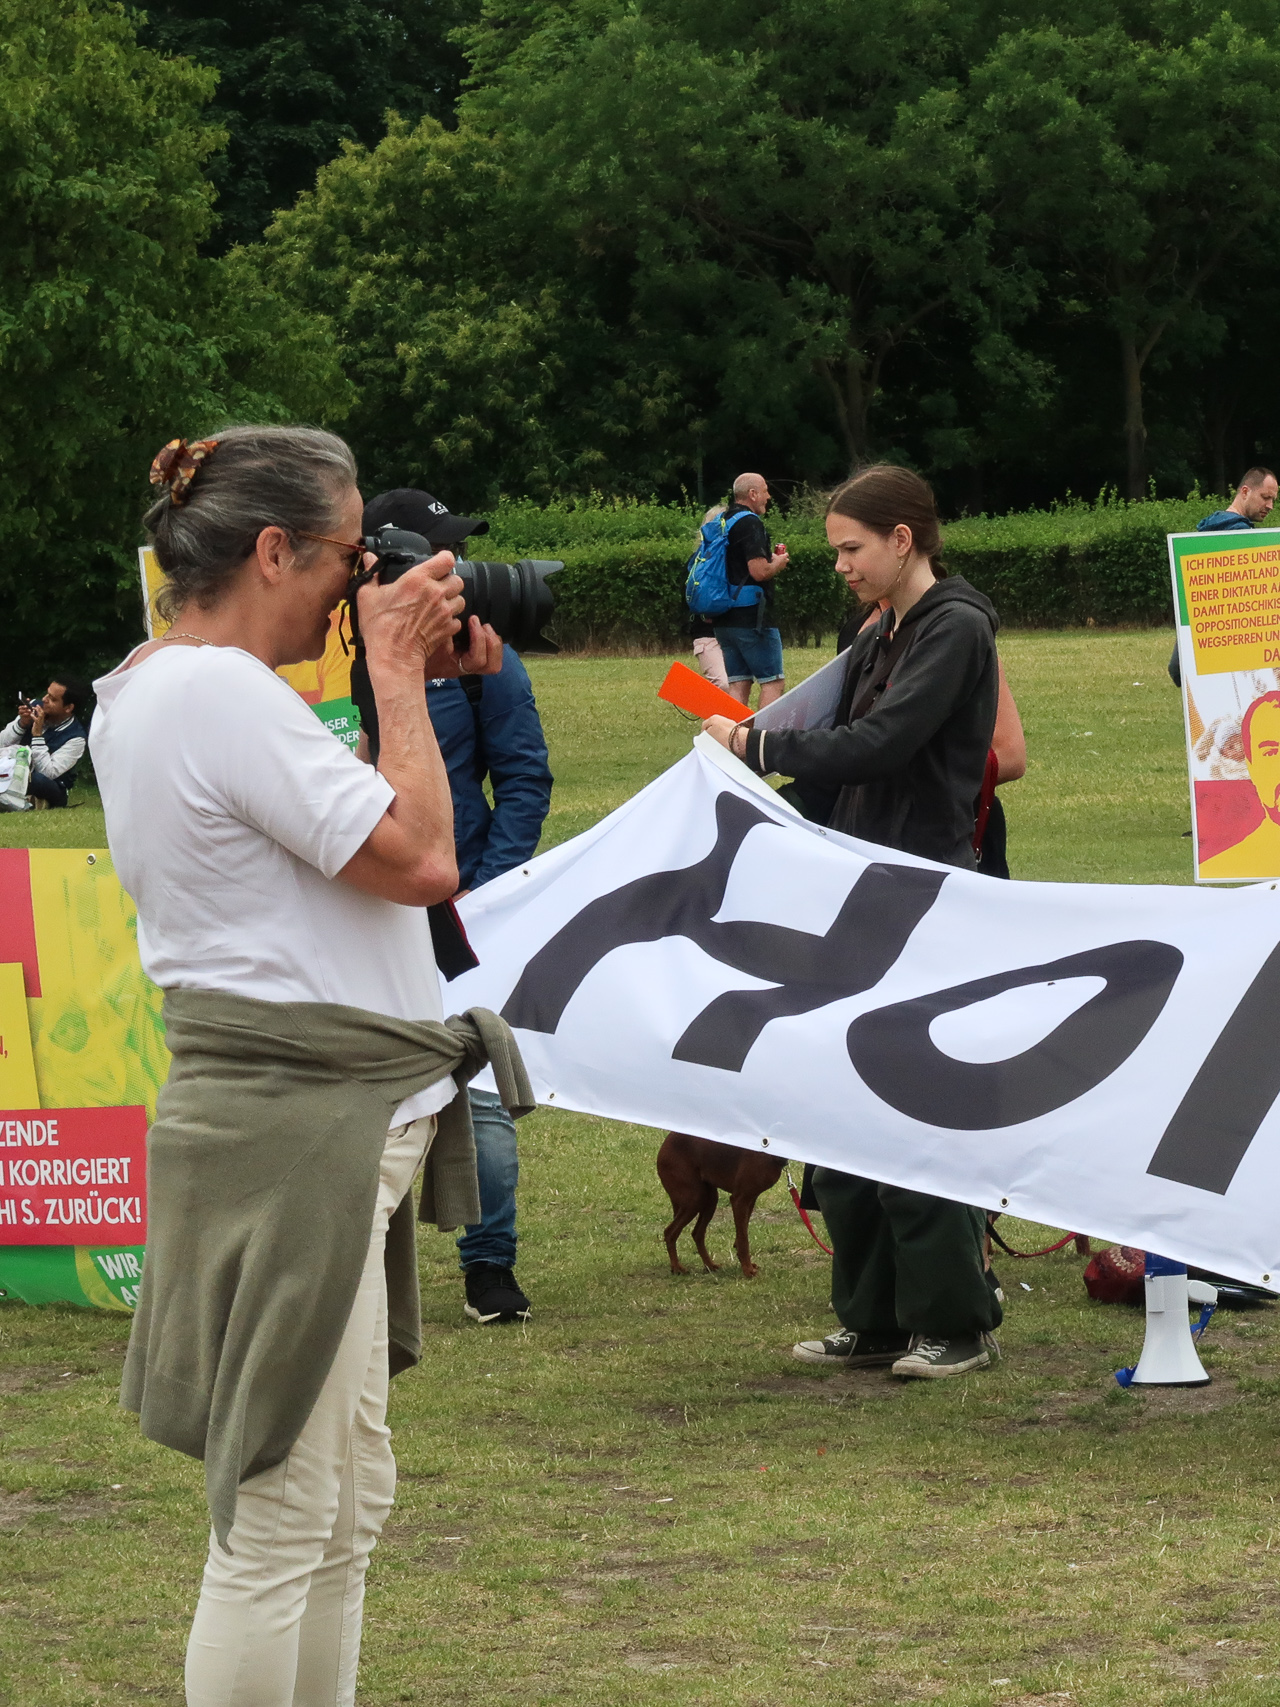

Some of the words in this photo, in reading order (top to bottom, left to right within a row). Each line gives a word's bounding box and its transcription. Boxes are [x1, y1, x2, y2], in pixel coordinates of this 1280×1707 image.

[1186, 558, 1205, 571] ICH
[1206, 556, 1236, 568] FINDE
[1237, 553, 1250, 566] ES
[1189, 573, 1215, 586] MEIN
[1217, 566, 1280, 583] HEIMATLAND
[1190, 589, 1219, 602] EINER
[1222, 583, 1268, 598] DIKTATUR
[1193, 603, 1225, 618] DAMIT
[1197, 631, 1263, 649] WEGSPERREN
[337, 730, 359, 744] DER
[8, 1157, 131, 1186] KORRIGIERT
[20, 1199, 41, 1225] S.
[44, 1190, 142, 1225] ZURÜCK!
[97, 1252, 142, 1280] WIR
